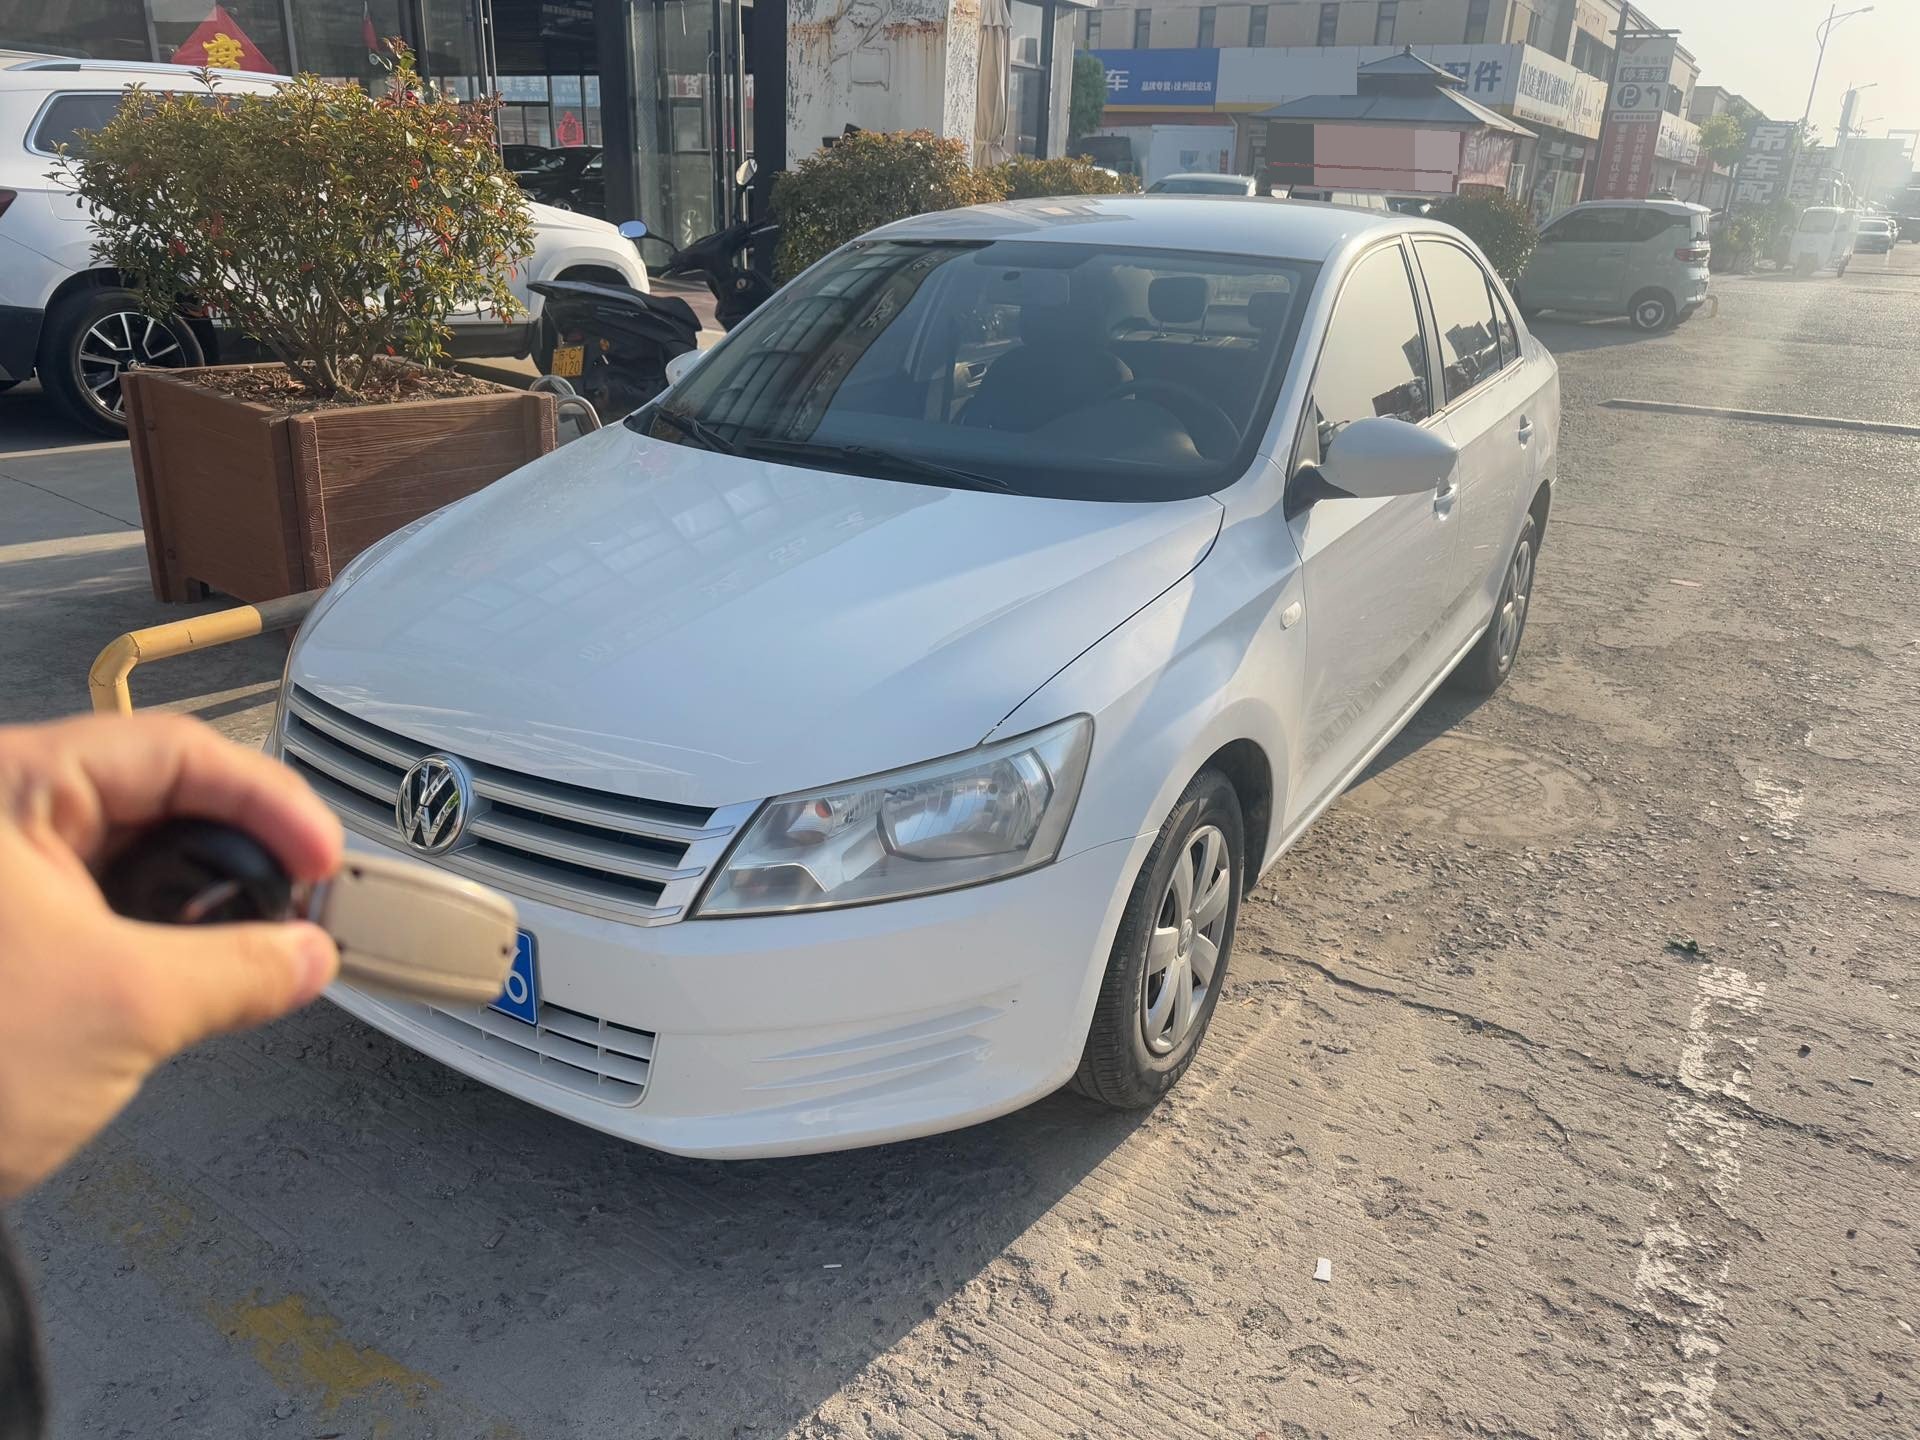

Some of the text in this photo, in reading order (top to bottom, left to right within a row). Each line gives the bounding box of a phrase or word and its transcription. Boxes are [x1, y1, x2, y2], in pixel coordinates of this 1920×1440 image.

[1105, 69, 1129, 91] 车
[1623, 68, 1664, 81] 停车场
[399, 757, 464, 852] VW
